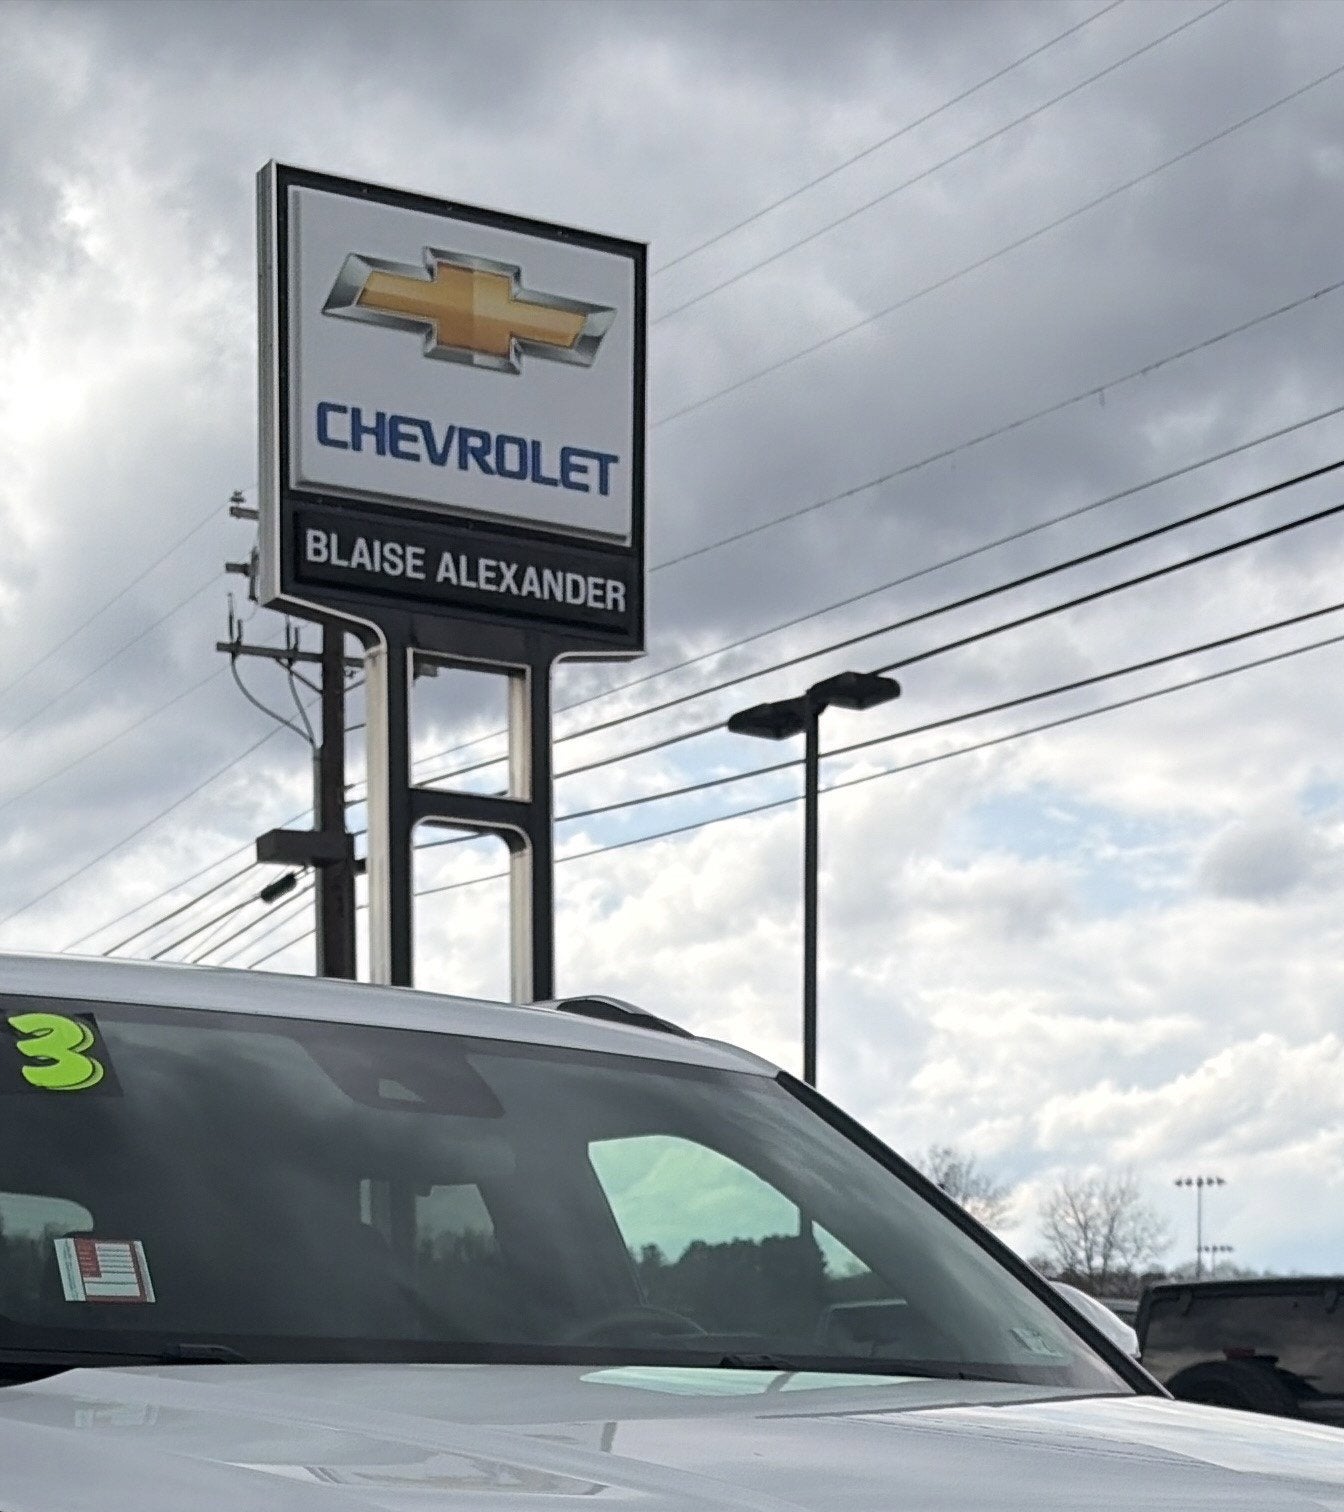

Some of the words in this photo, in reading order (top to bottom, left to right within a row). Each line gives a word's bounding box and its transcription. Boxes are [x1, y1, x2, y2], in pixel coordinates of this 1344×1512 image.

[317, 401, 619, 496] CHEVROLET
[306, 528, 426, 580] BLAISE
[436, 552, 626, 612] ALEXANDER
